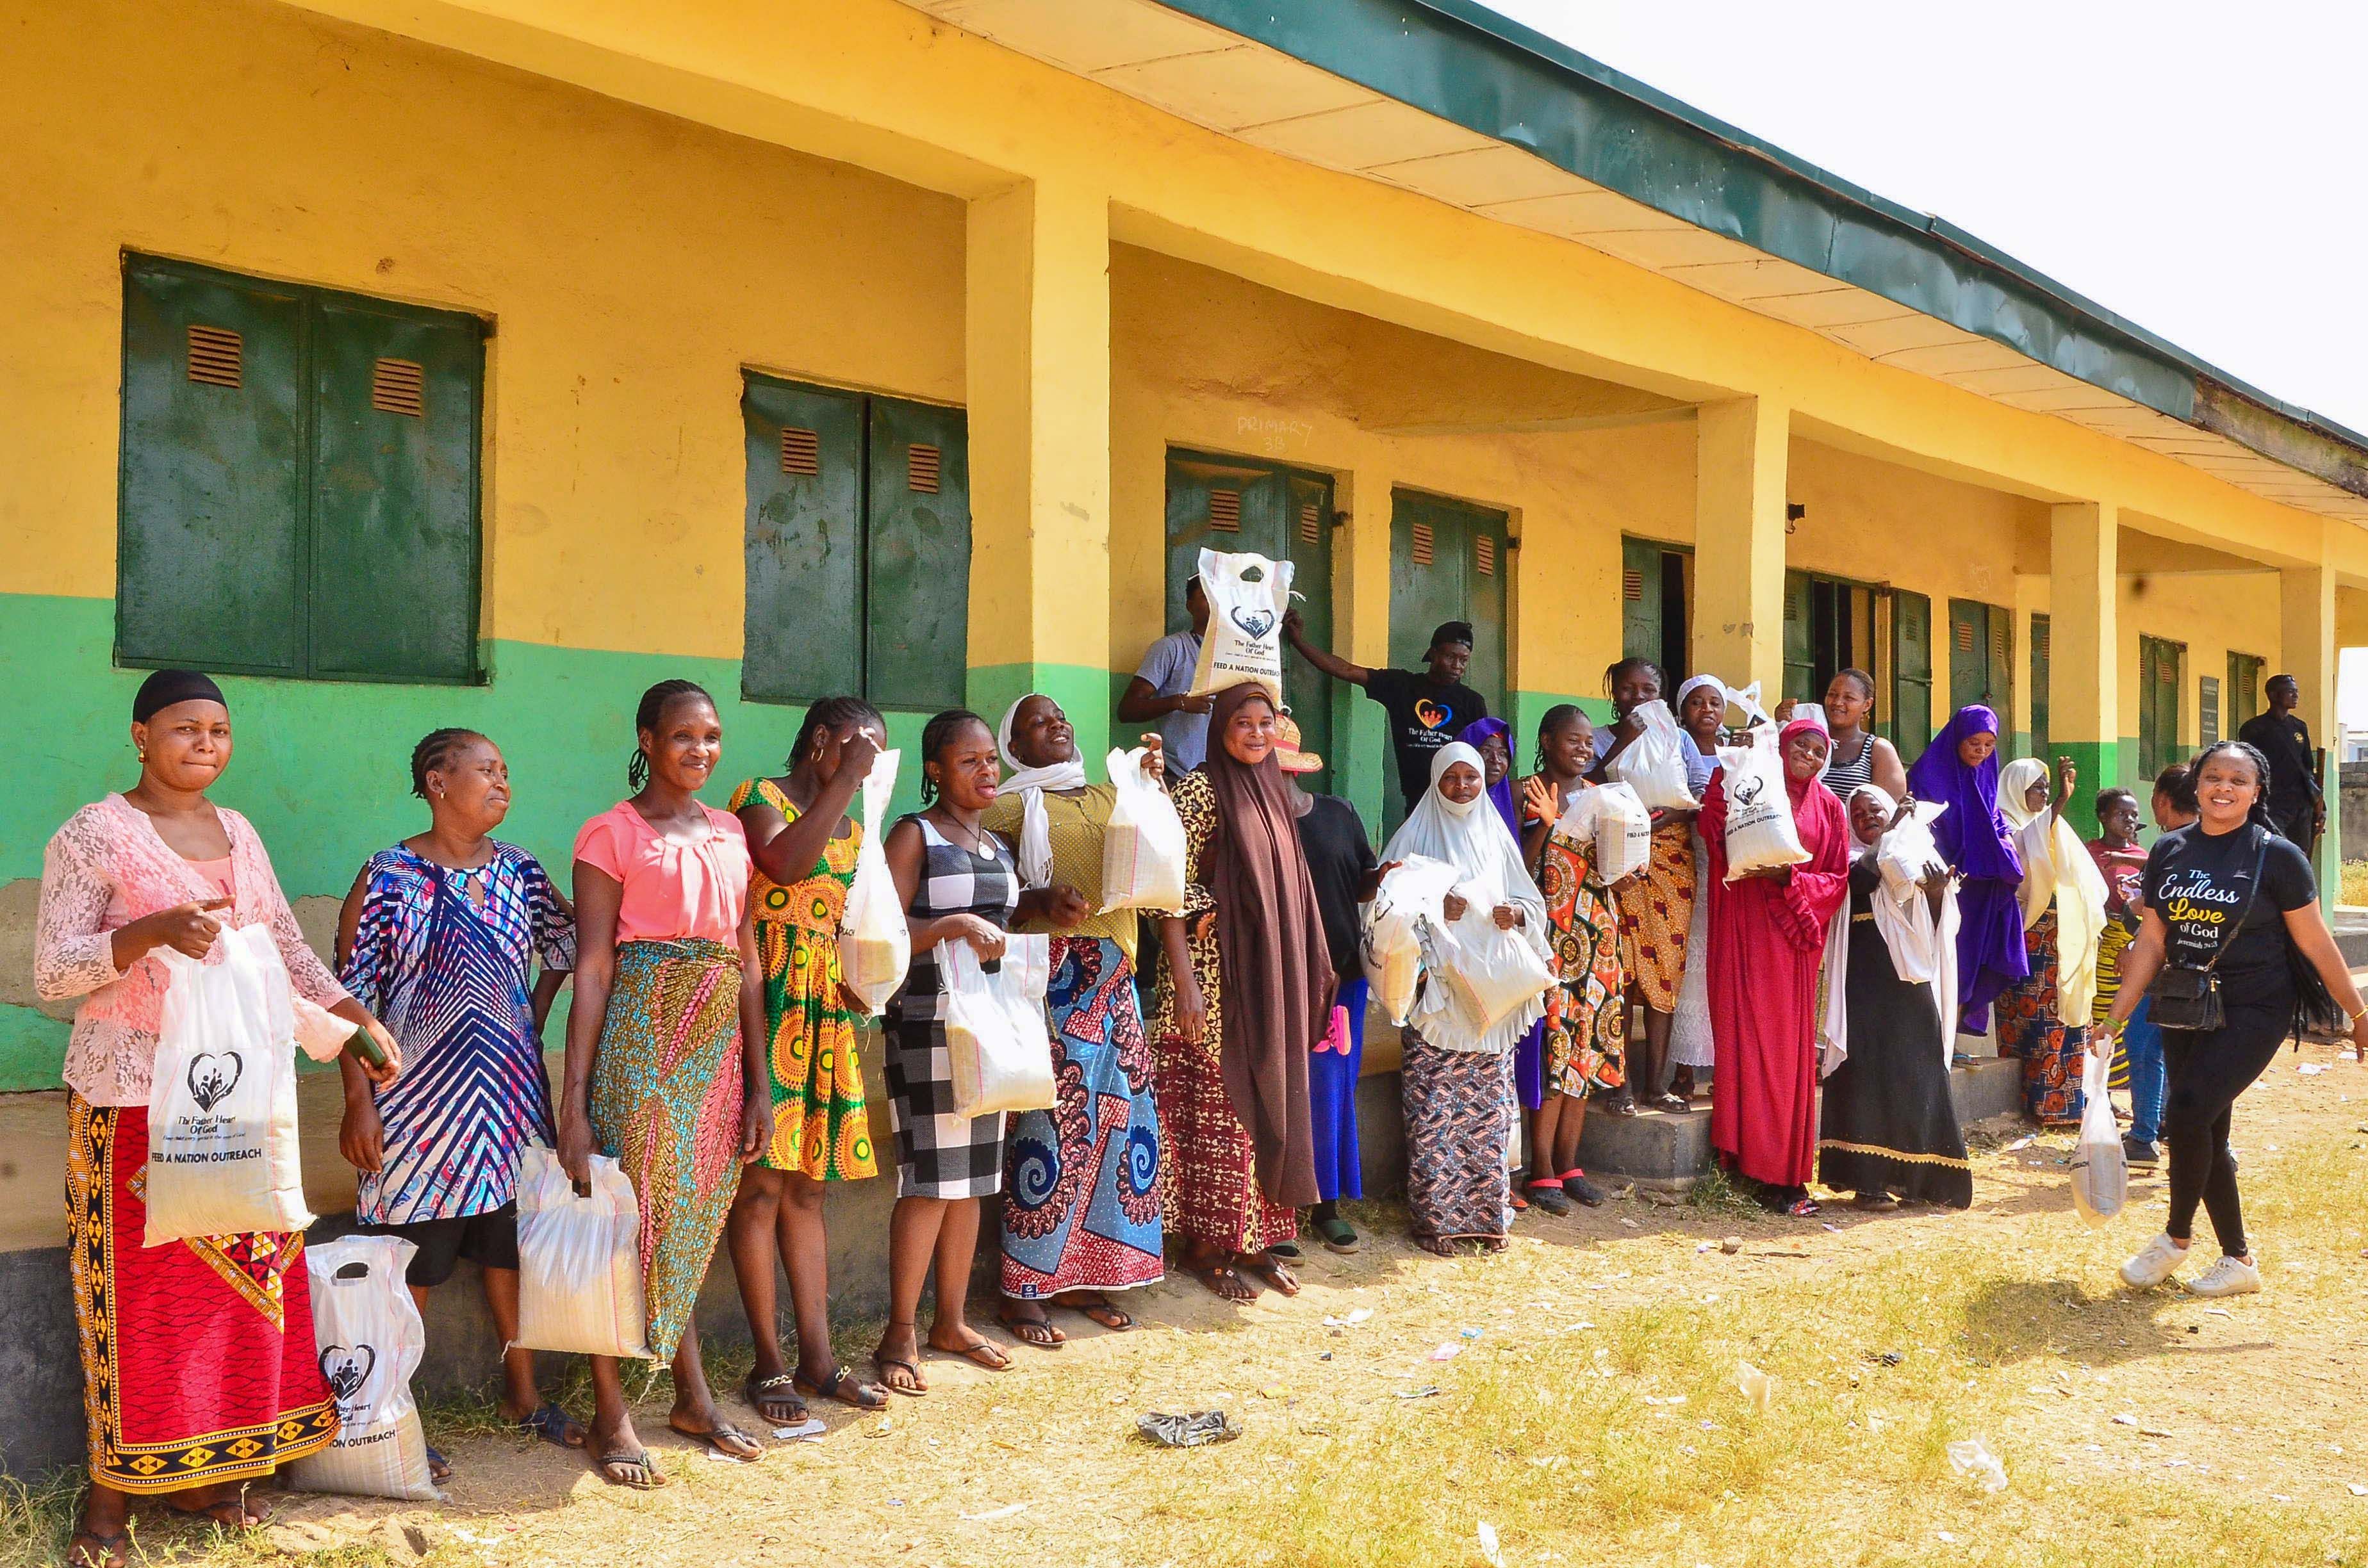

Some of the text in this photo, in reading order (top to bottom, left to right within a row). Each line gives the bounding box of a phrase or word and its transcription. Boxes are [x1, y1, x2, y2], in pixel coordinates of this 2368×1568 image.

[1238, 416, 1312, 446] PRIMARY
[1235, 665, 1258, 674] NATION
[1738, 820, 1756, 829] NATION
[2189, 869, 2210, 879] The
[2158, 874, 2240, 904] Endless
[2168, 897, 2226, 924] Love
[2180, 922, 2219, 938] of God
[190, 1125, 218, 1134] Of God
[165, 1153, 172, 1163] A
[174, 1152, 211, 1163] NATION
[211, 1148, 262, 1163] OUTREACH
[348, 1429, 395, 1447] OUTREACH
